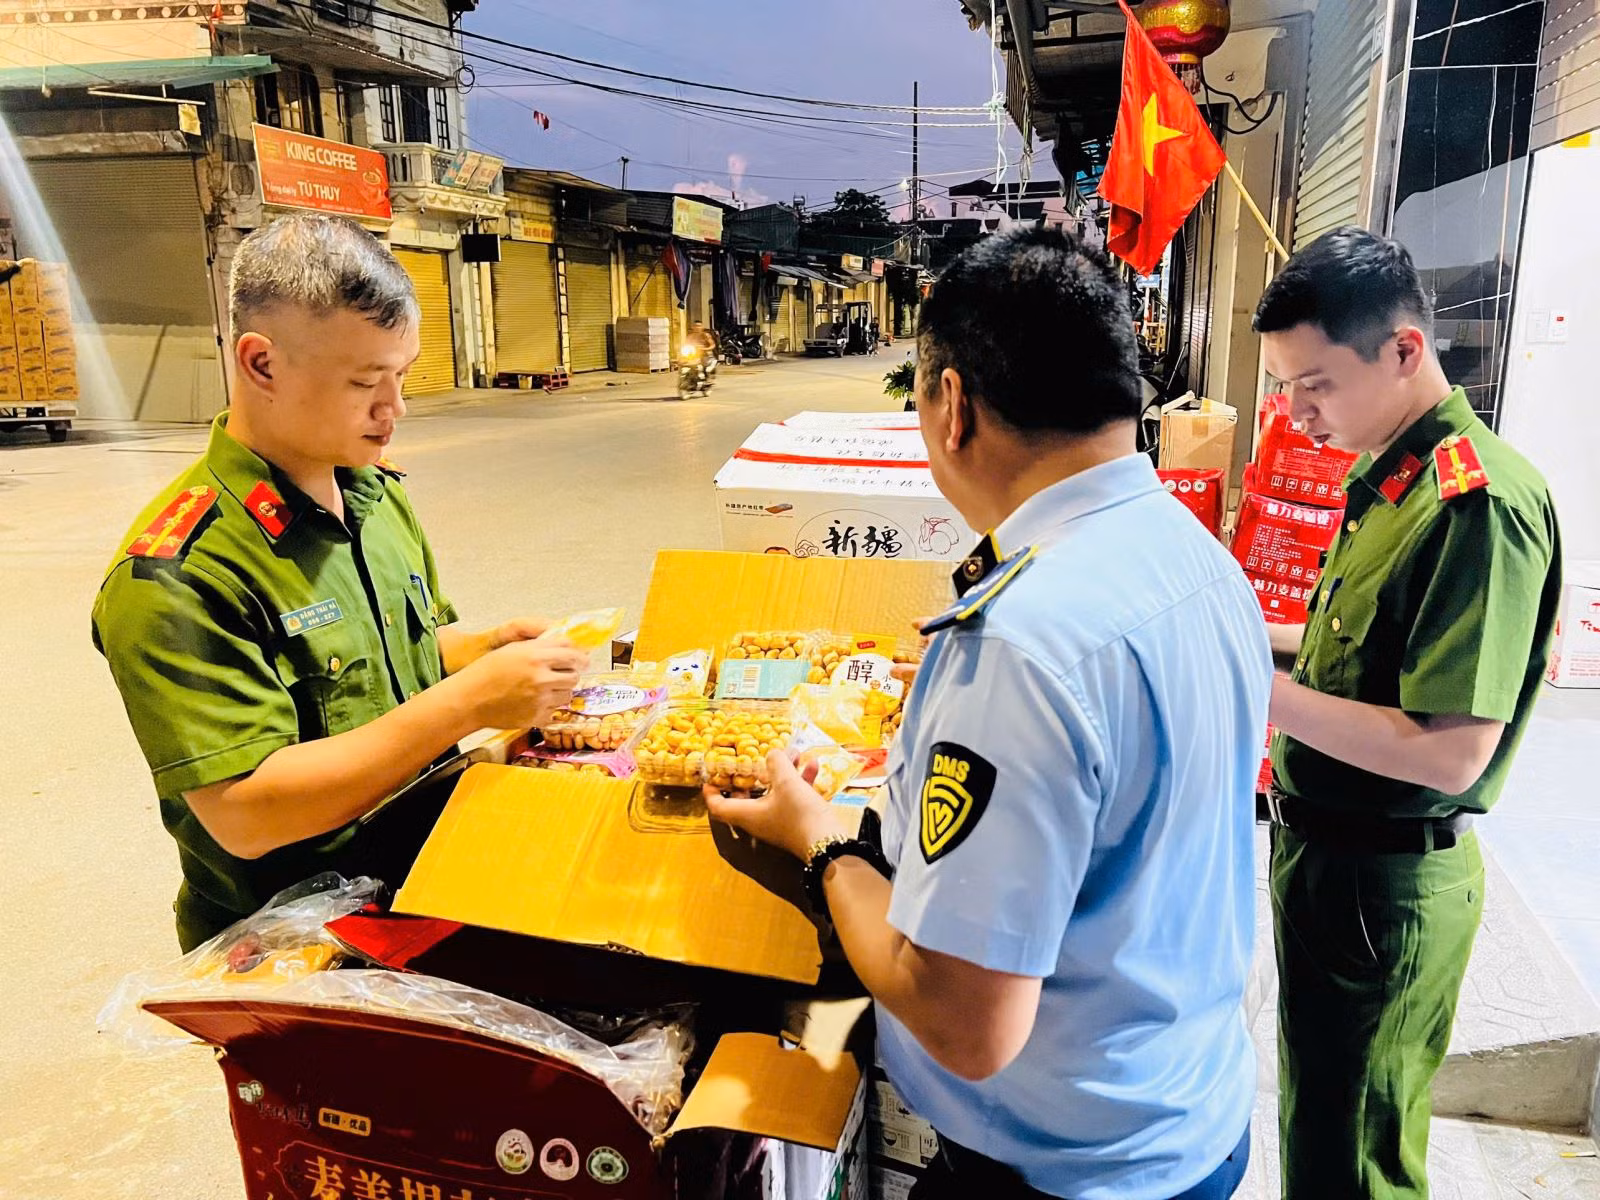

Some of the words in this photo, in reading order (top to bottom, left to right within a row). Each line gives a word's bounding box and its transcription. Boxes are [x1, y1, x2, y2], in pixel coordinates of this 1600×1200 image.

[286, 141, 316, 164] KING
[316, 147, 357, 171] COFFEE
[822, 519, 903, 558] 新疆
[846, 659, 875, 684] 醇
[932, 753, 970, 783] DMS
